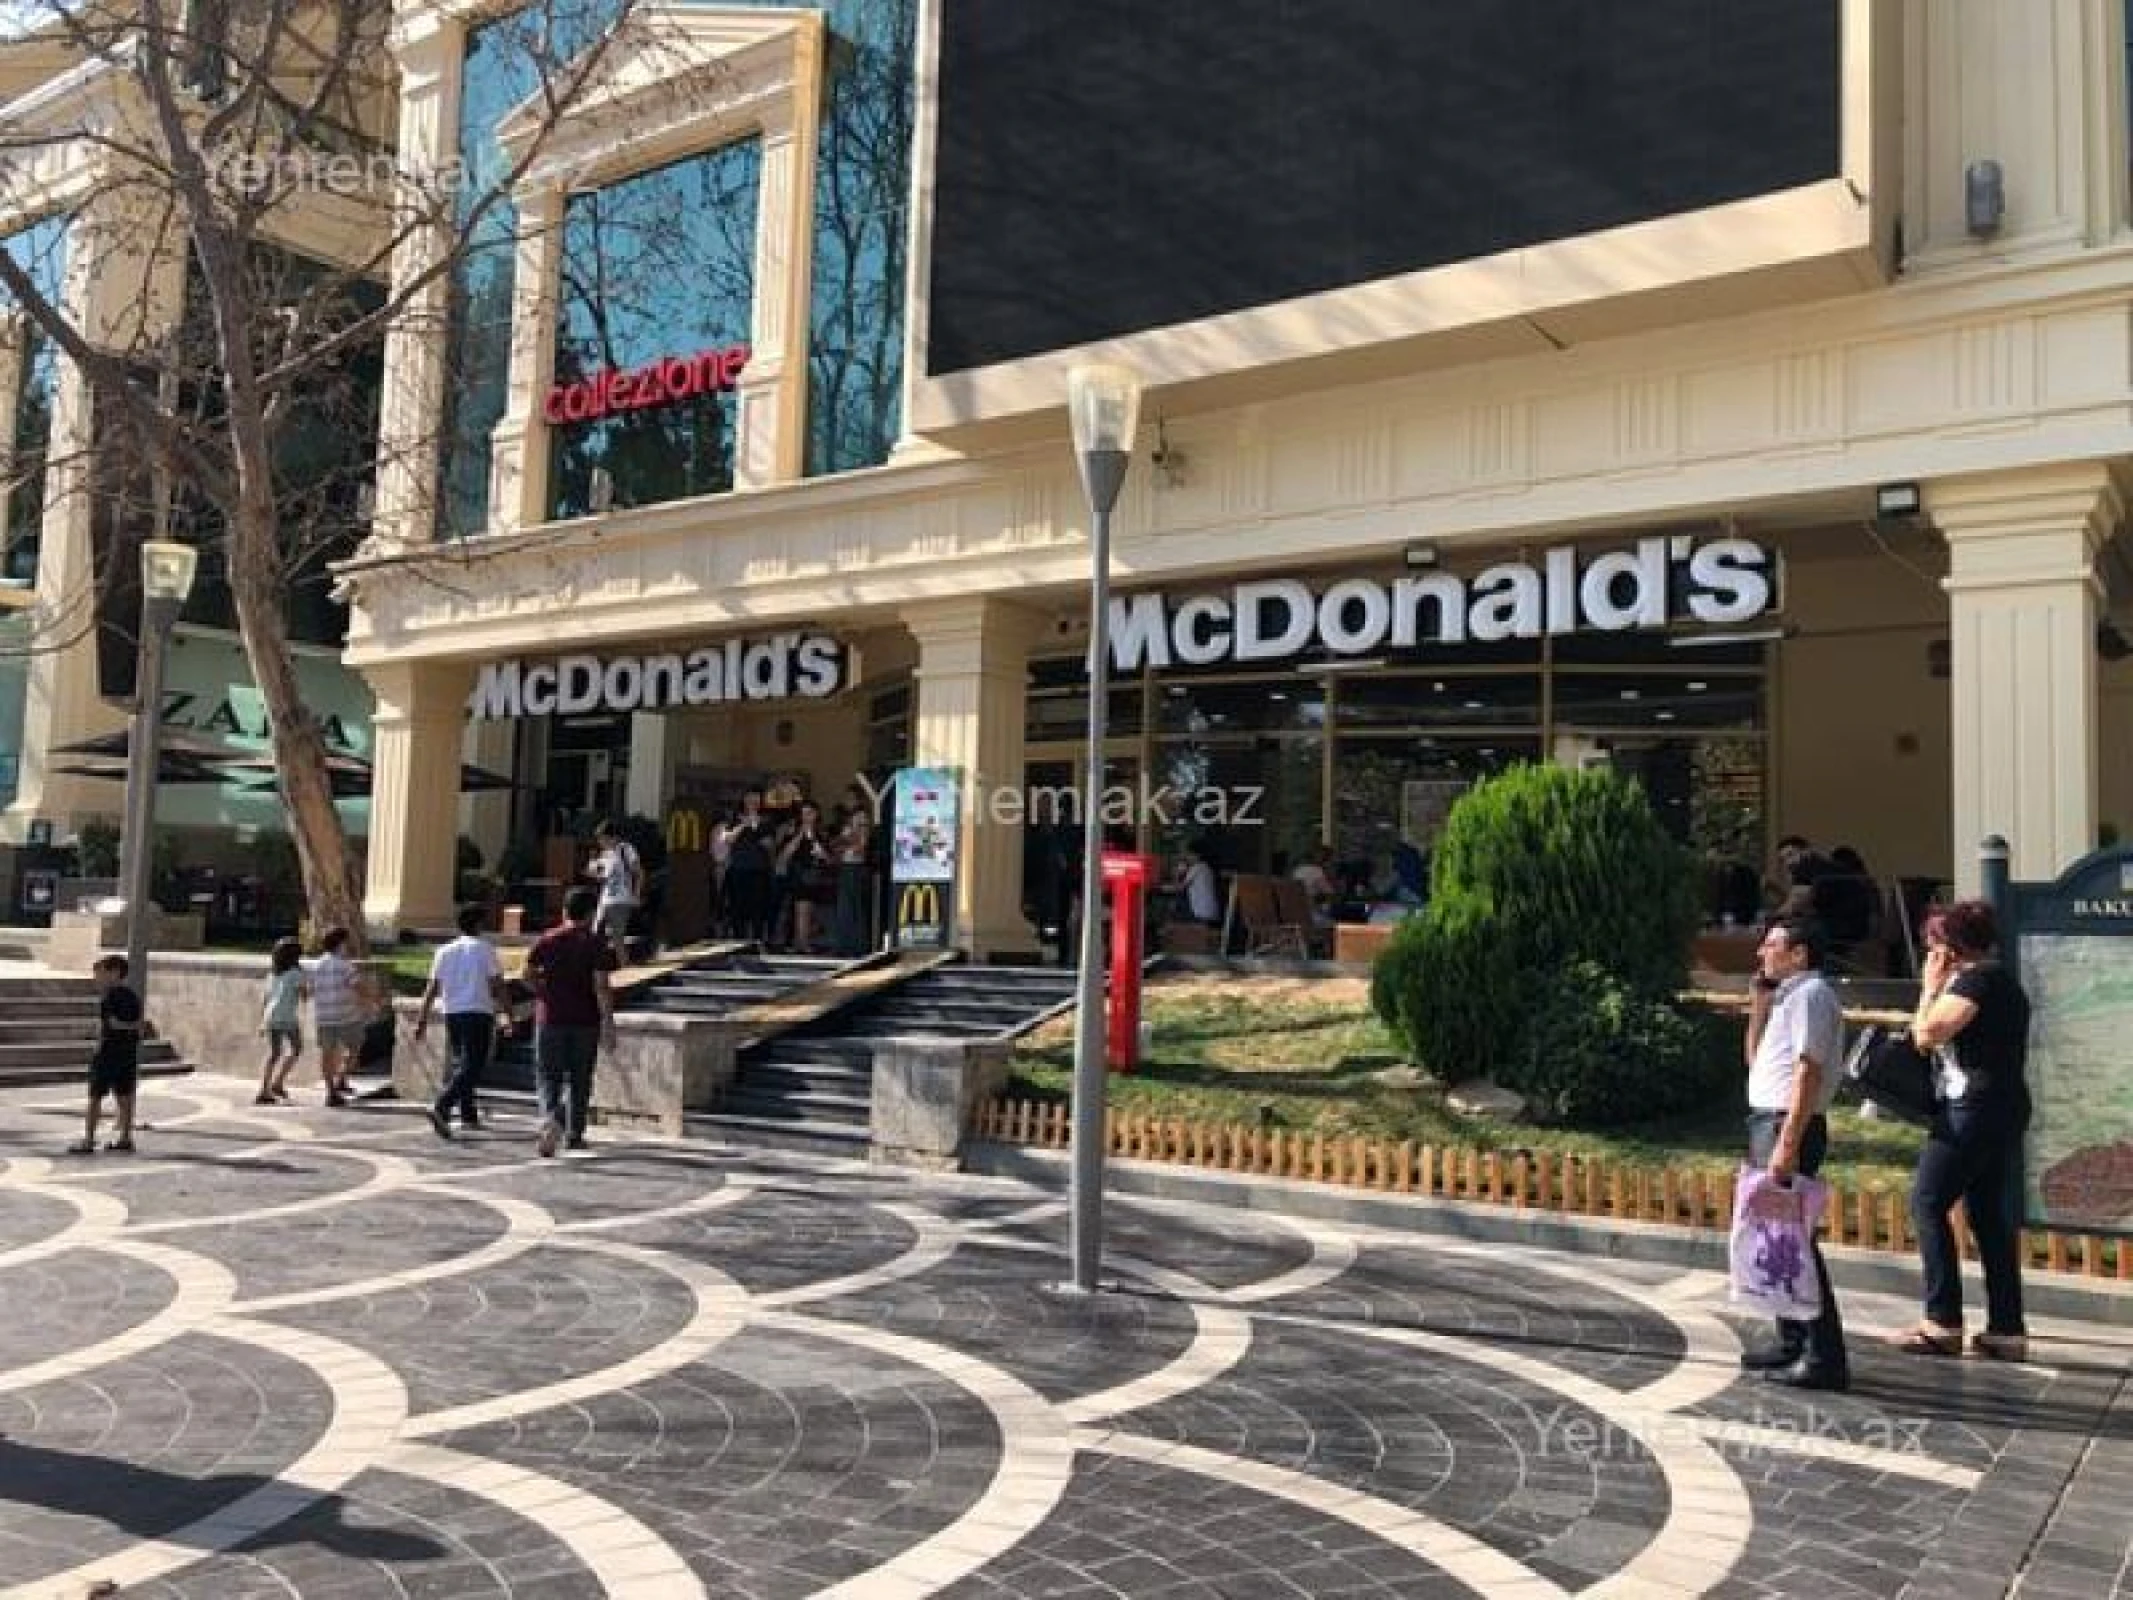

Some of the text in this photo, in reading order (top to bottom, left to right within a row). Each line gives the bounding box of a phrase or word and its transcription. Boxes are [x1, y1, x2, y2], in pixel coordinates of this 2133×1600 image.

[1087, 535, 1770, 672] McDonald's
[161, 690, 352, 747] ZAA
[465, 633, 840, 720] McDonald's
